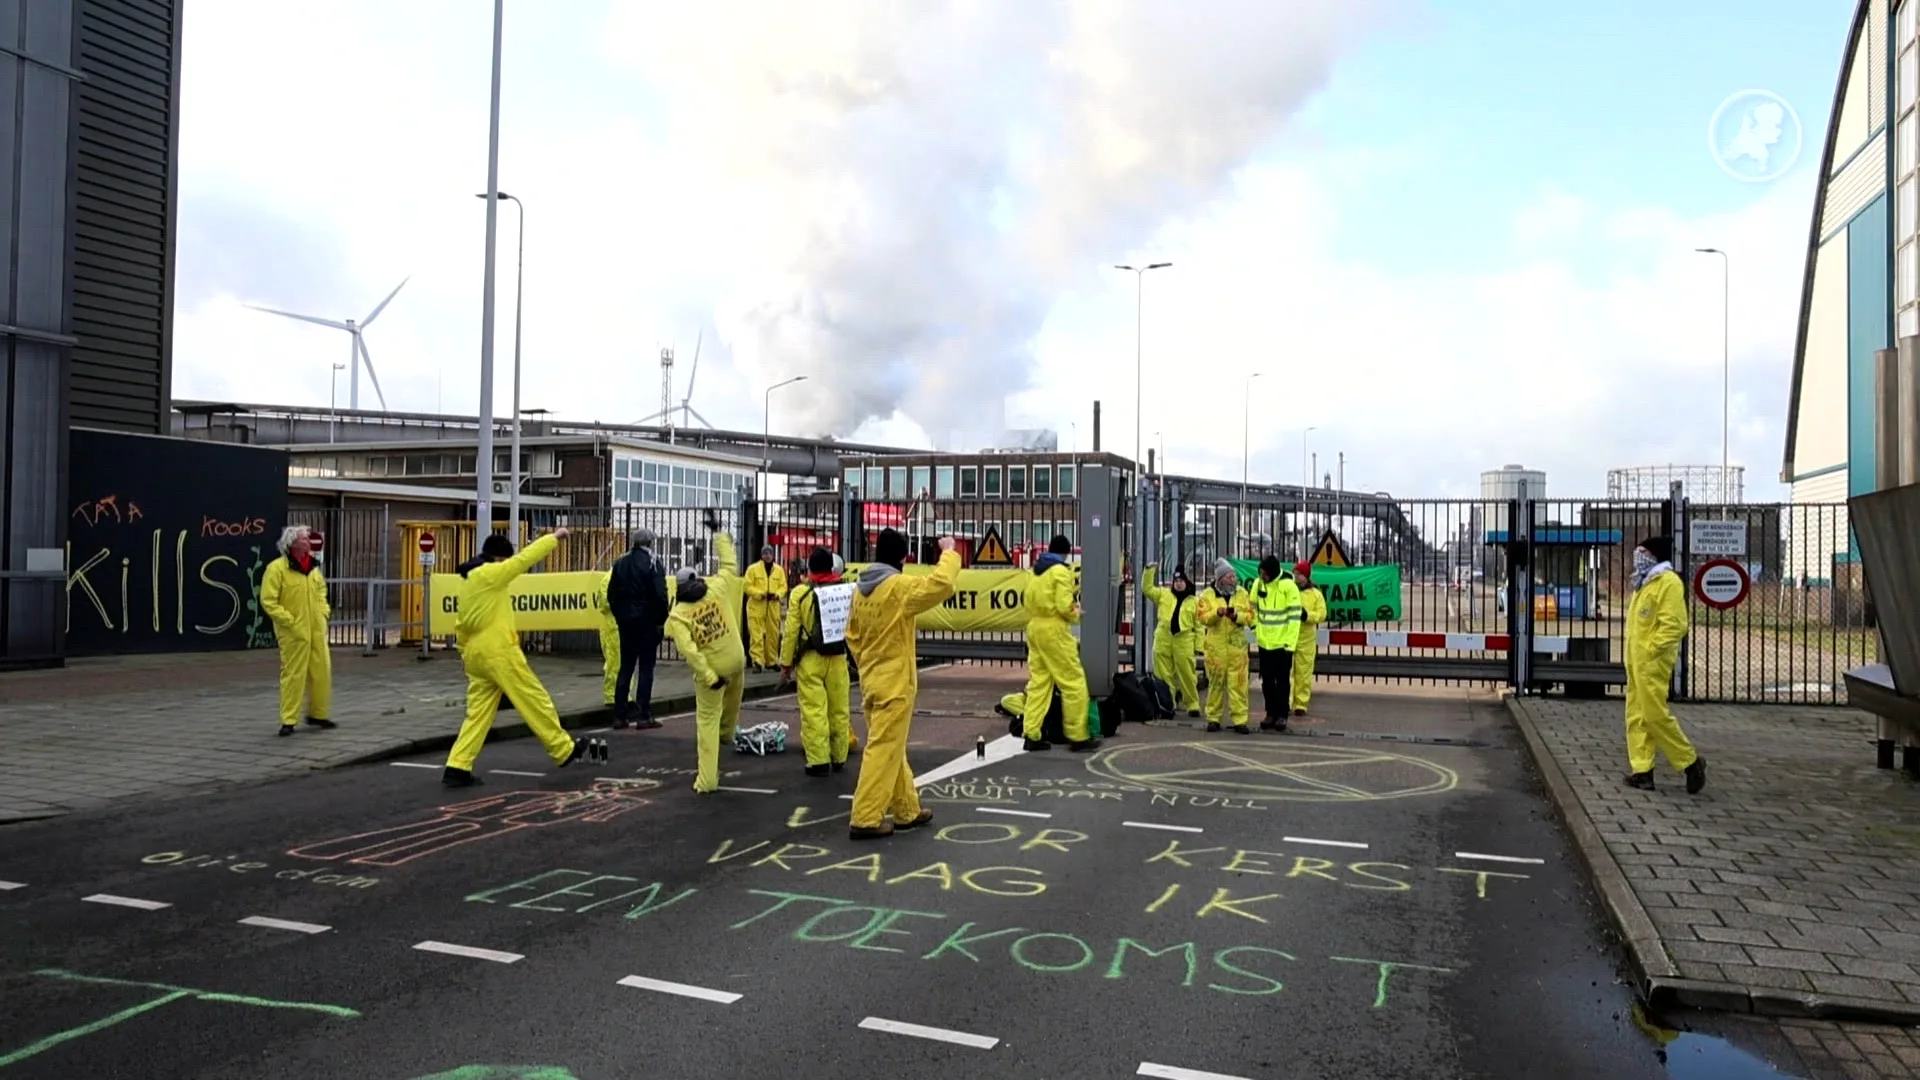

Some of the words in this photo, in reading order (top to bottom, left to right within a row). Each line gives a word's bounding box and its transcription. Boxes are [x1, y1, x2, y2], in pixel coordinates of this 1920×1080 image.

[786, 806, 1089, 852] VOR
[706, 839, 1048, 897] VRAAG
[1143, 883, 1284, 924] IK
[464, 868, 700, 919] EEN
[730, 889, 1453, 1008] TOEKOMST
